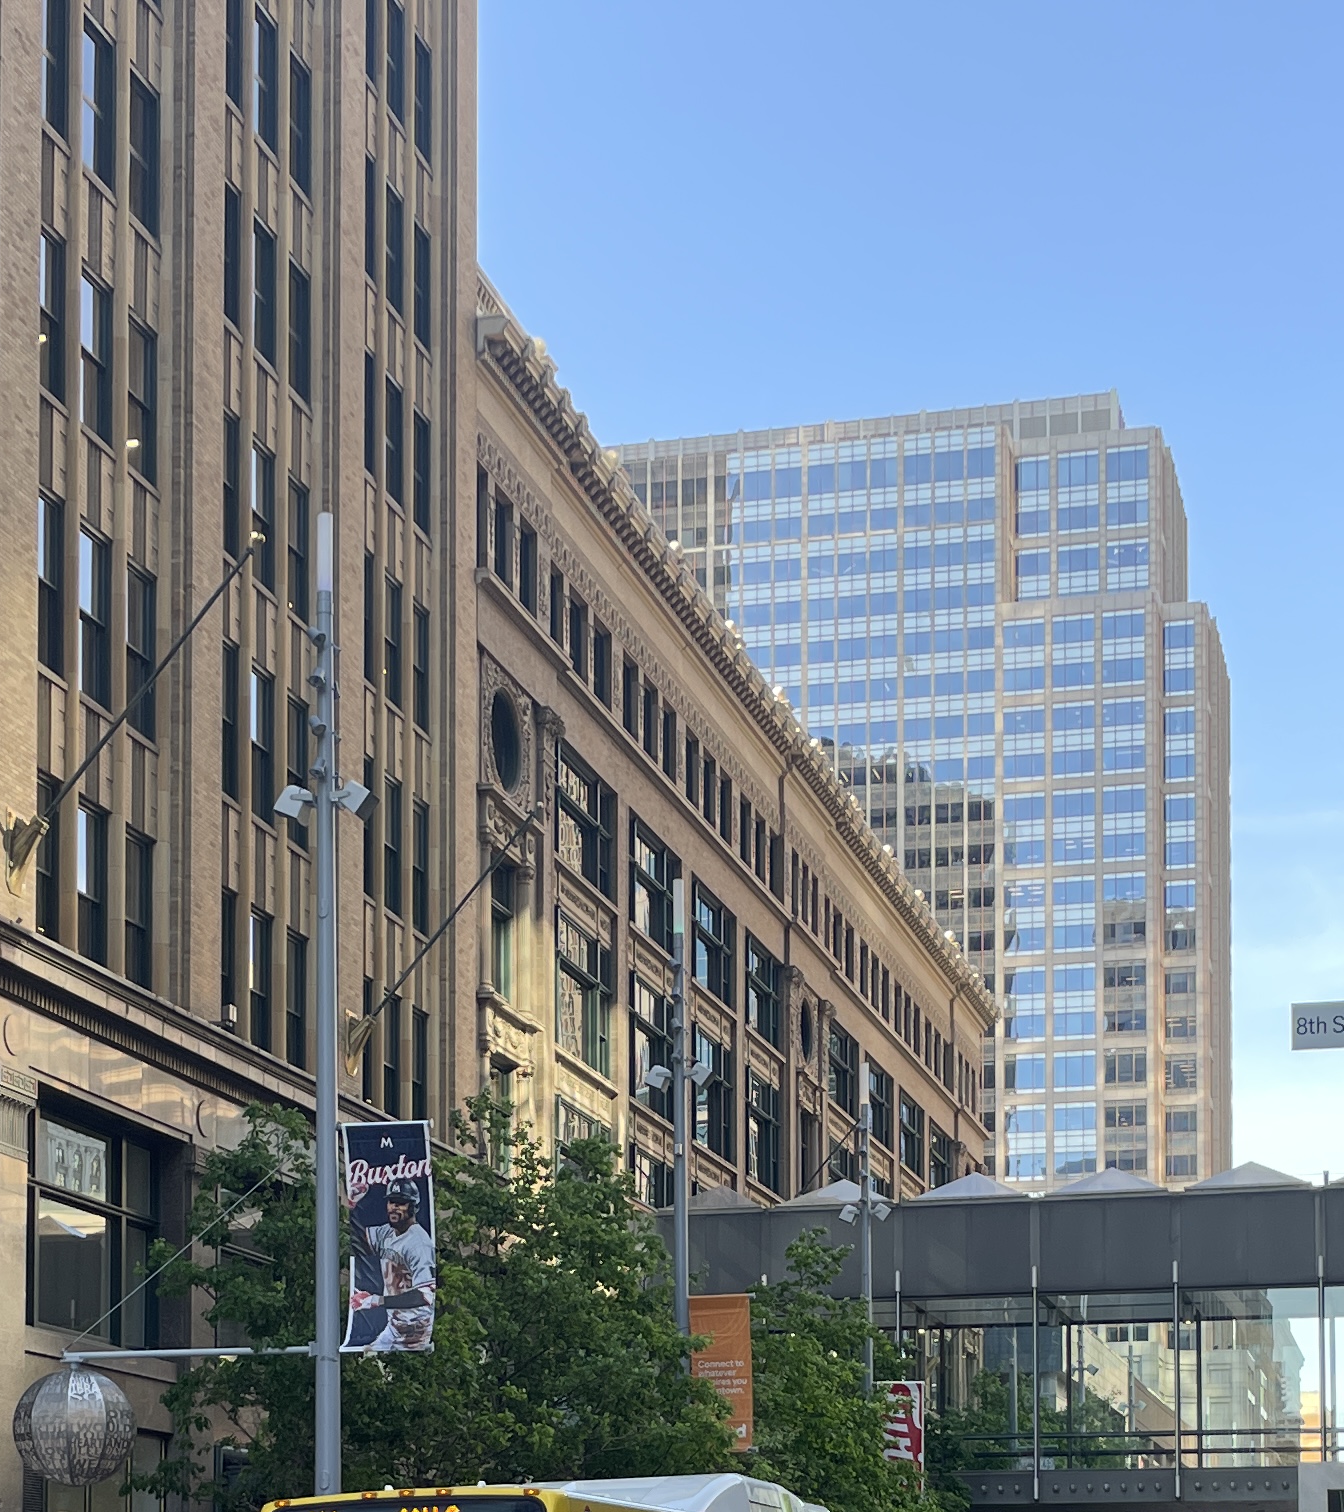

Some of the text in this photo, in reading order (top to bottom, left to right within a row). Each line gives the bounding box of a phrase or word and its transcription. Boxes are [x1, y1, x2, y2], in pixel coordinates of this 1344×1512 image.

[1296, 1015, 1327, 1036] 8th
[349, 1153, 432, 1186] Buxton
[697, 1359, 734, 1369] Connect
[731, 1378, 748, 1387] you
